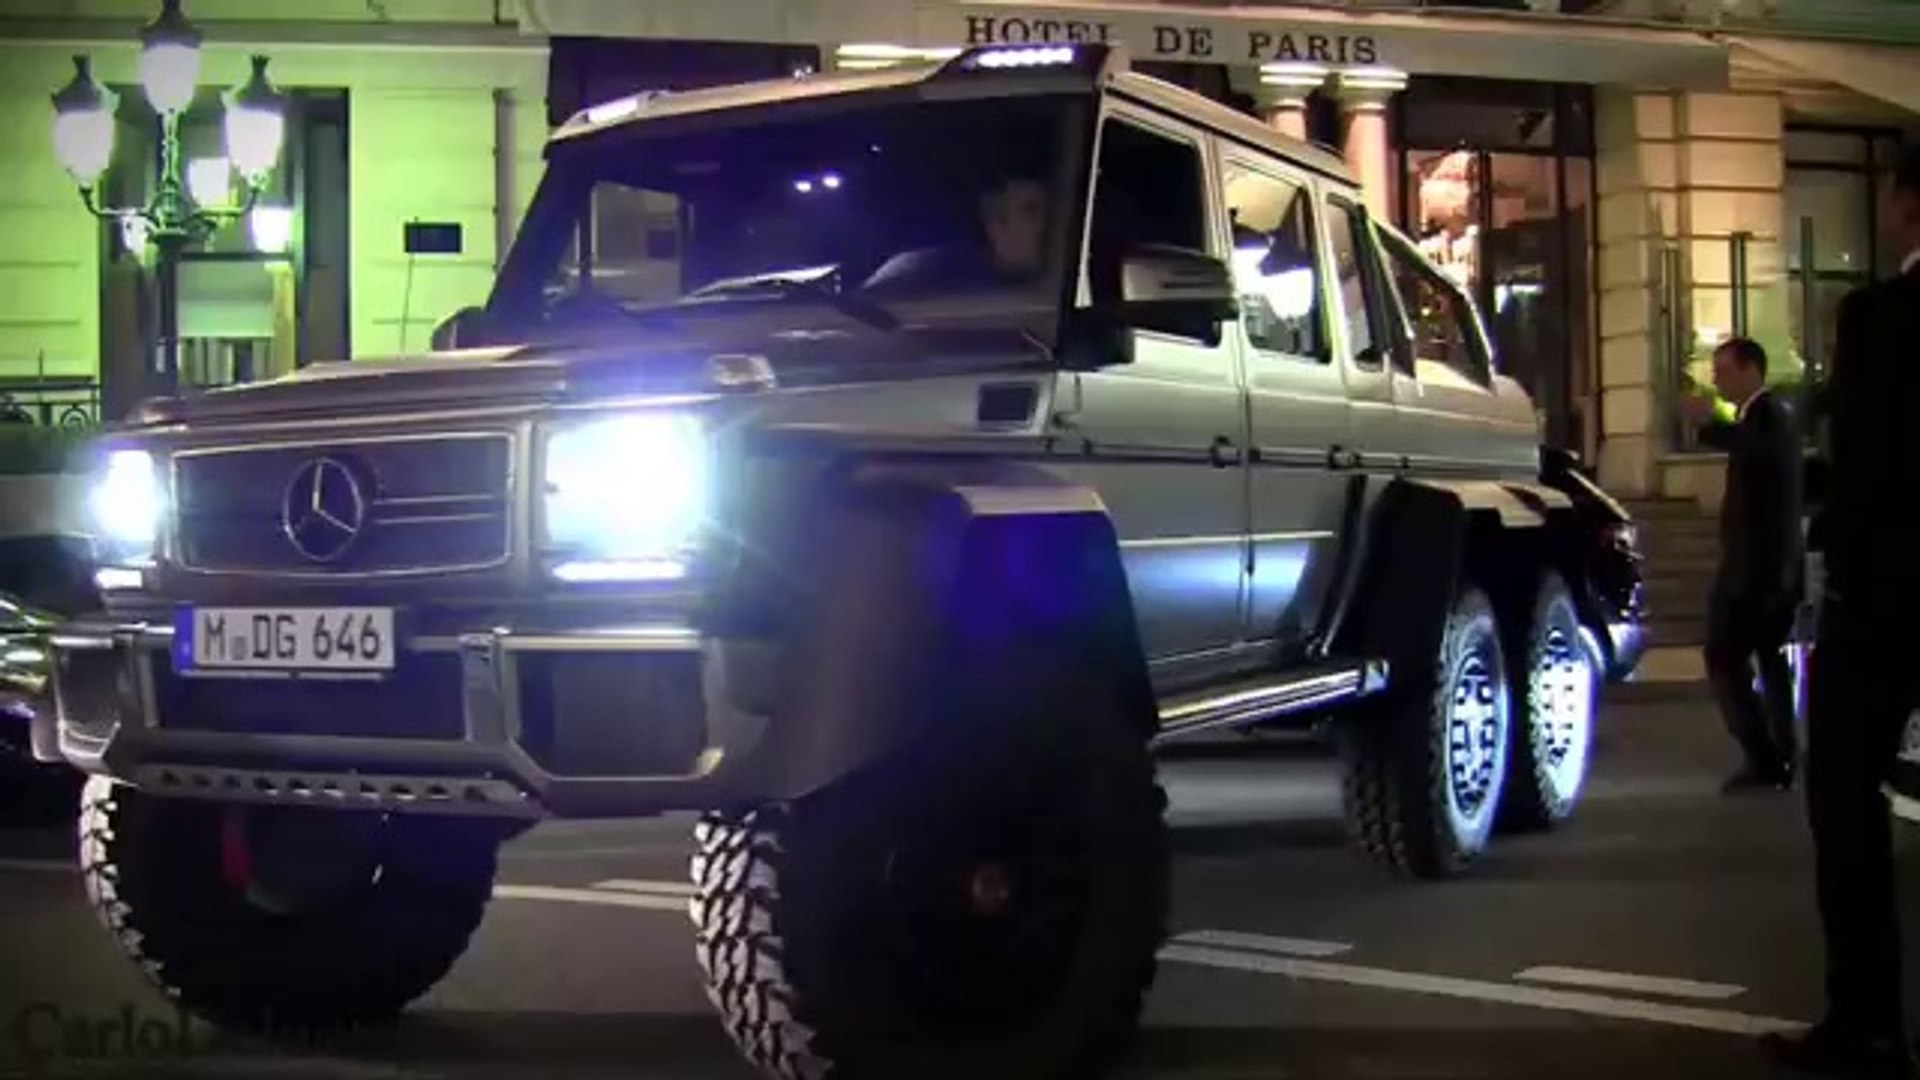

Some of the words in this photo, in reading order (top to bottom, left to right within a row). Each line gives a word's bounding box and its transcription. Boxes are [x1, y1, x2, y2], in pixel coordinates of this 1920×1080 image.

[966, 15, 1108, 44] HOTEL
[1153, 26, 1213, 56] DE
[1248, 31, 1377, 64] PARIS
[204, 612, 226, 659] M
[252, 613, 297, 660] DG
[313, 613, 380, 660] 646
